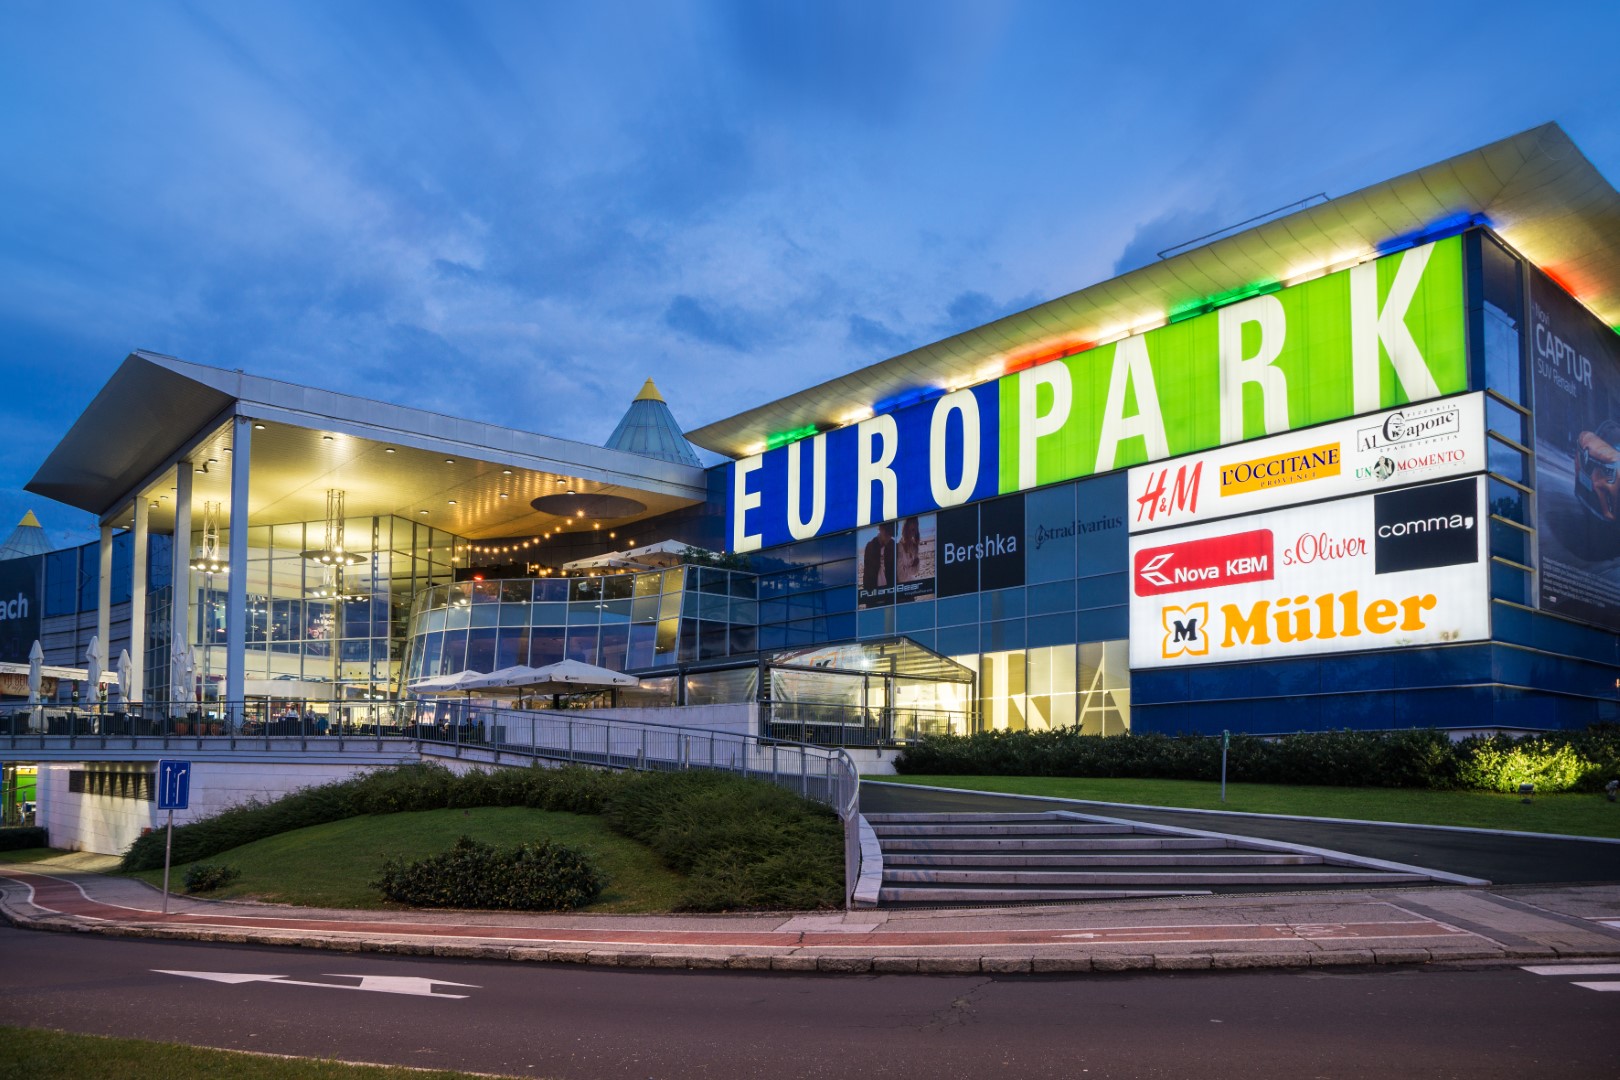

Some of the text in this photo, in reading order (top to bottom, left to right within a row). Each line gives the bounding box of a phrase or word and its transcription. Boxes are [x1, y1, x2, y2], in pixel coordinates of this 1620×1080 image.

[1536, 322, 1593, 390] CAPTUR
[1537, 357, 1552, 380] SUV
[732, 242, 1443, 554] EUROPARK
[1361, 411, 1455, 453] Al Capone
[1260, 472, 1318, 488] PROVENCE
[1355, 465, 1372, 479] UN
[1396, 449, 1466, 472] MOMENTO
[1136, 460, 1204, 523] H&M
[944, 533, 1018, 565] Bershka
[1282, 531, 1369, 566] s.Oliver
[1174, 554, 1268, 584] Nova KBM
[1172, 589, 1437, 648] M Müller
